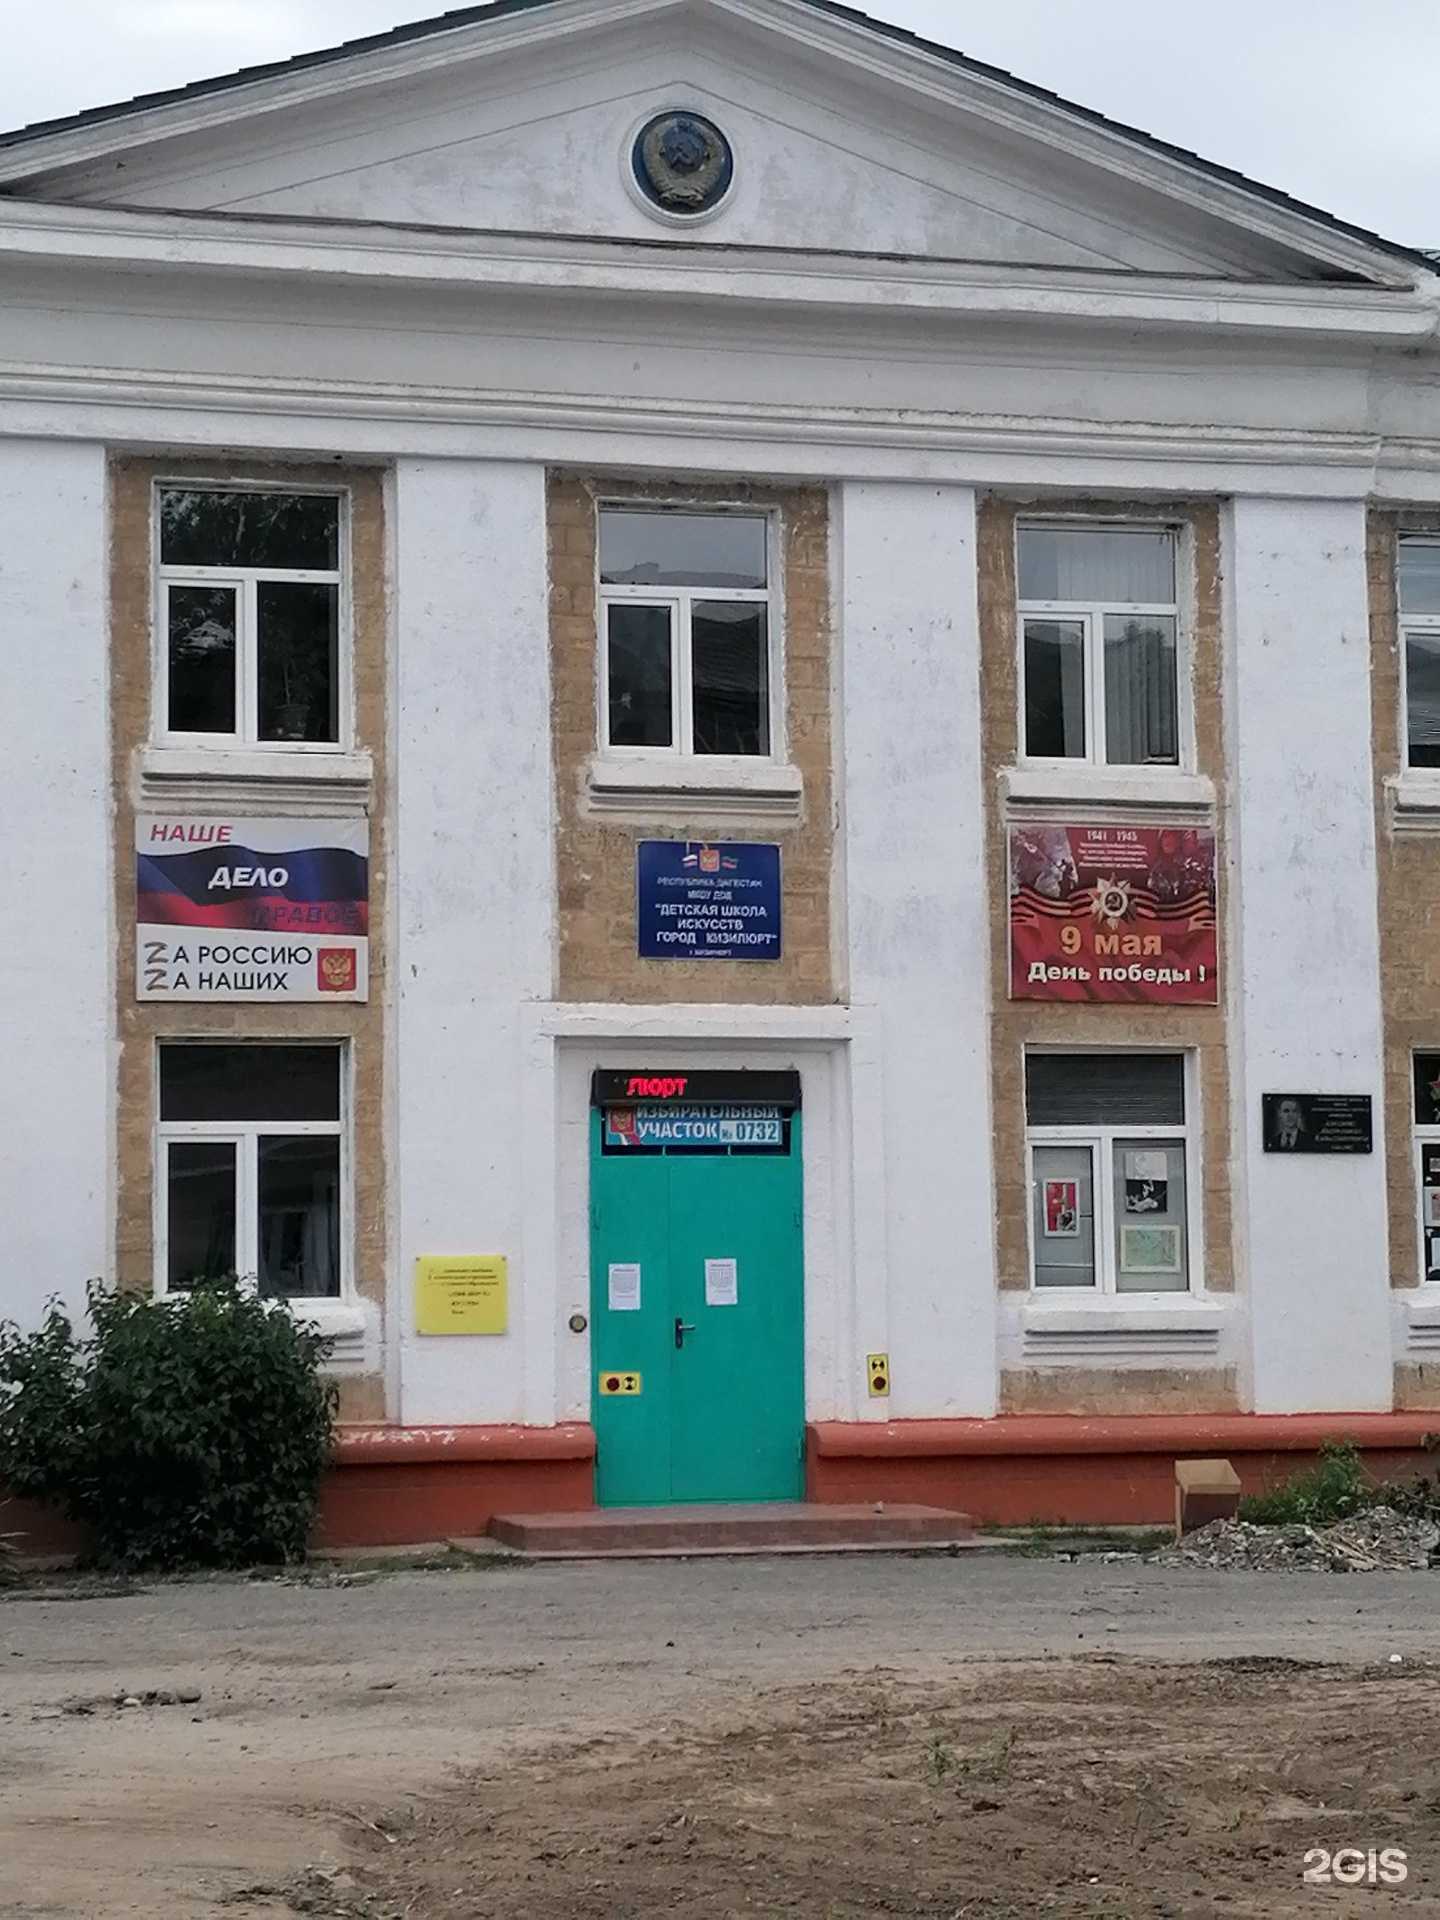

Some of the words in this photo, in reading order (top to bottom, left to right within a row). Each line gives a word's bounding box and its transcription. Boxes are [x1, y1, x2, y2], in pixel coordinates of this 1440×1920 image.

[150, 824, 233, 843] НАШЕ
[208, 866, 289, 889] ДЕЛО
[721, 906, 767, 917] ШКОЛА
[678, 918, 743, 930] ИСКУССТВ
[656, 931, 696, 944] ГОРОД
[1060, 926, 1082, 955] 9
[1094, 935, 1162, 956] мая
[199, 946, 312, 965] РОССИЮ
[199, 972, 288, 991] НАШИХ
[1028, 962, 1092, 983] День
[1099, 964, 1191, 985] победы
[637, 1120, 718, 1139] УЧАСТОК
[736, 1121, 777, 1141] 0732
